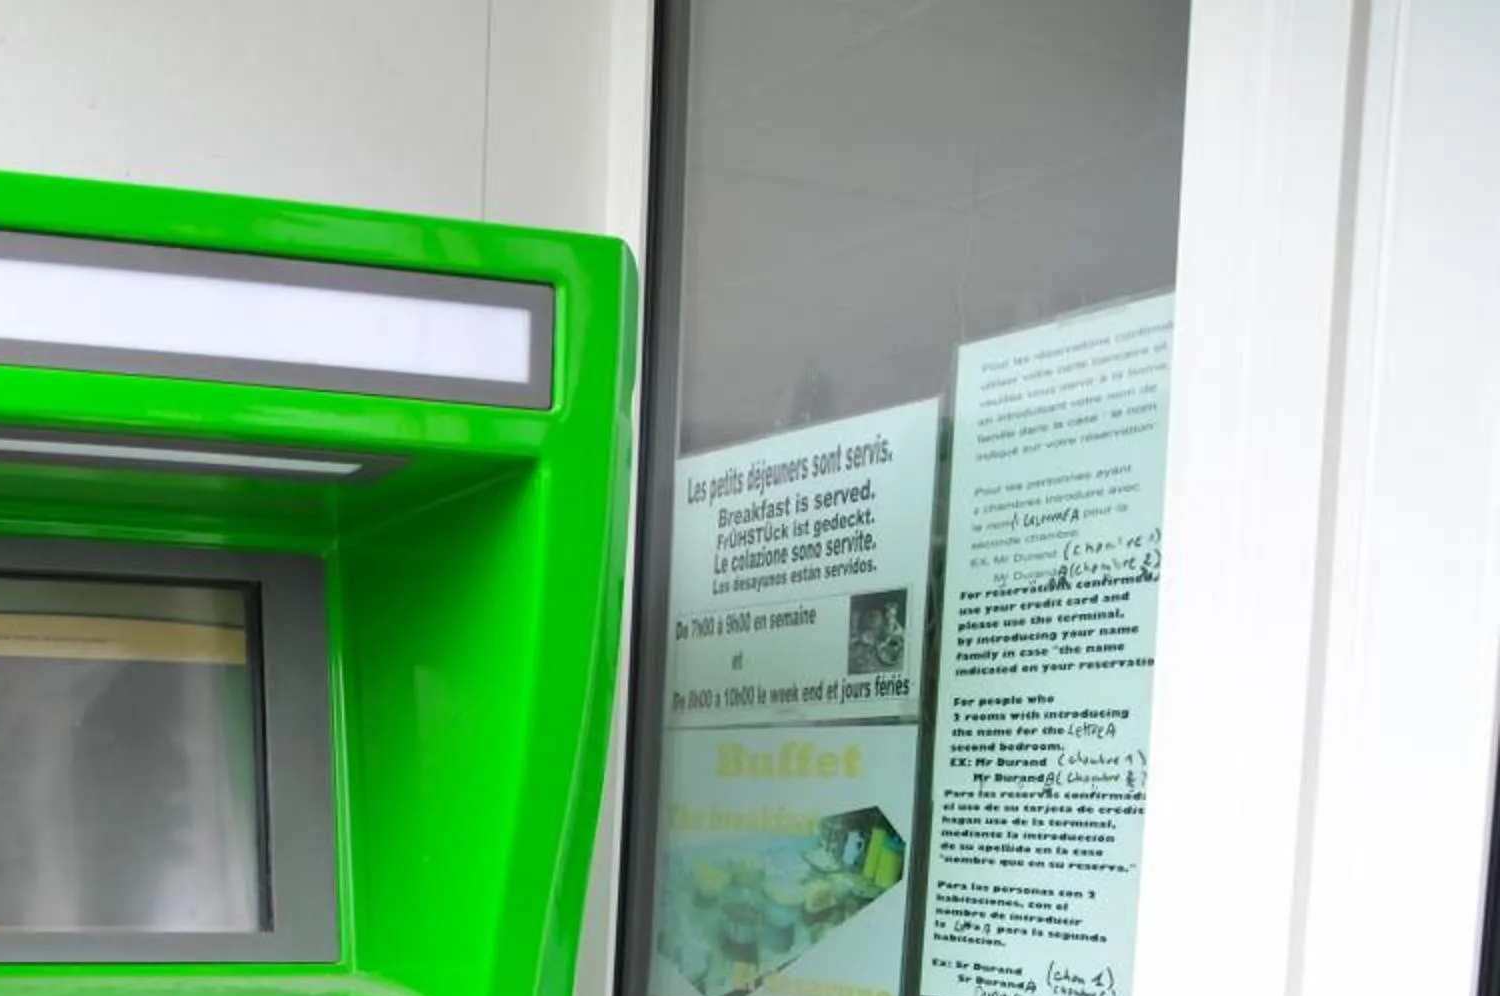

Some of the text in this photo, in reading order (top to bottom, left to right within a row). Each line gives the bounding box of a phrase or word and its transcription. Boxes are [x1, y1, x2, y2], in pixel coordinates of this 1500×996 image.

[718, 481, 875, 528] Breakfast is served.
[714, 741, 864, 779] Buffet
